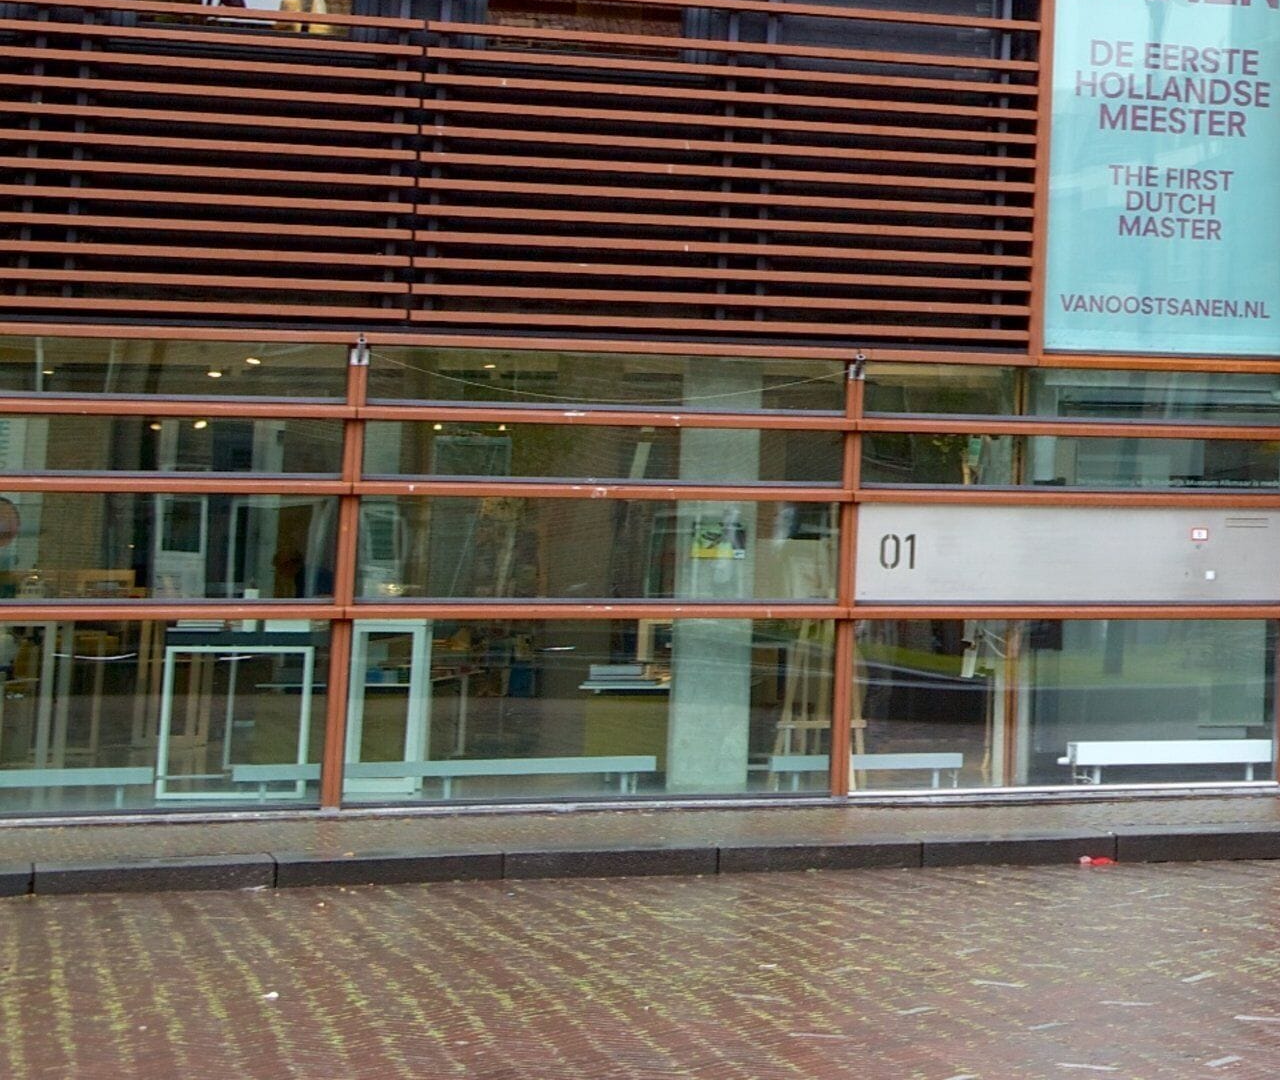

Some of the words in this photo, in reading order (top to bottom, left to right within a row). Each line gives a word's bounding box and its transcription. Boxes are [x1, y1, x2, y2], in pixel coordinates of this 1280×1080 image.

[1090, 39, 1134, 68] DE
[1144, 42, 1259, 76] EERSTE
[1075, 70, 1271, 108] HOLLANDSE
[1099, 103, 1247, 138] MEESTER
[1108, 164, 1158, 188] THE
[1166, 168, 1234, 191] FIRST
[1126, 191, 1216, 215] DUTCH
[1118, 215, 1222, 241] MASTER
[1060, 294, 1271, 319] VANOOSTSANEN.NL
[879, 533, 917, 569] 01
